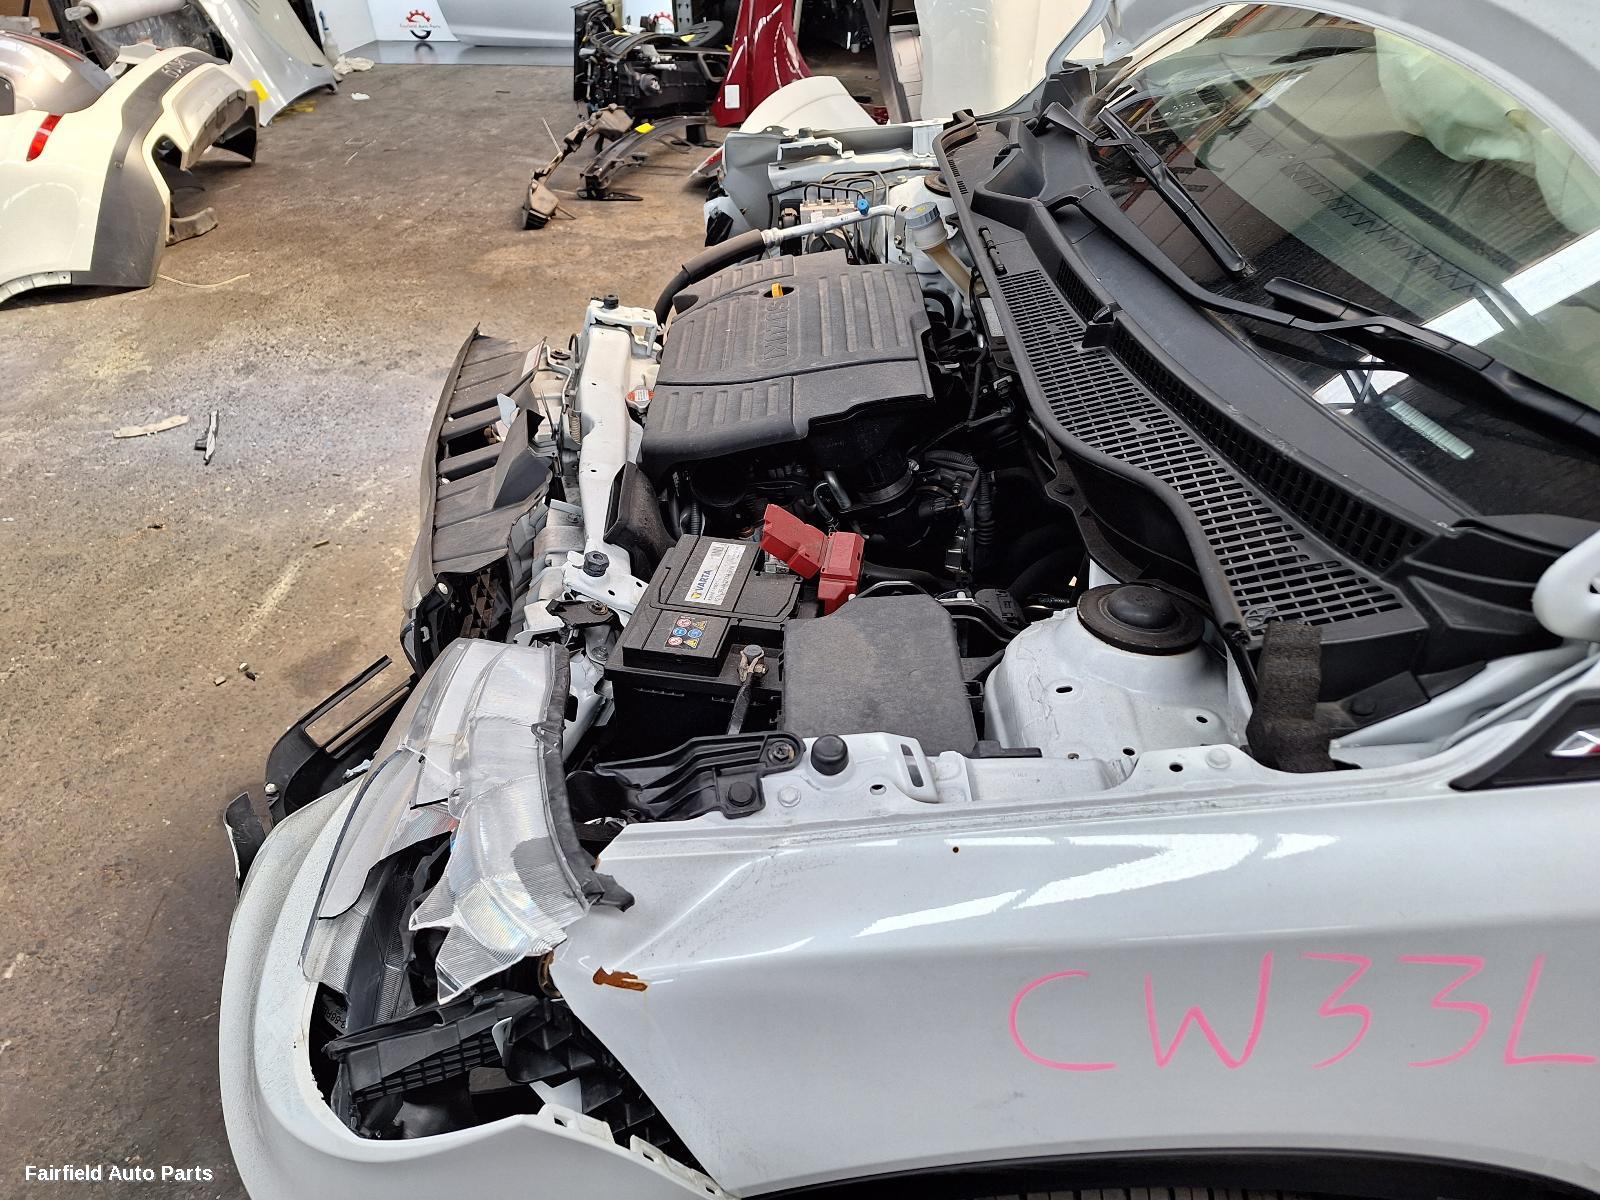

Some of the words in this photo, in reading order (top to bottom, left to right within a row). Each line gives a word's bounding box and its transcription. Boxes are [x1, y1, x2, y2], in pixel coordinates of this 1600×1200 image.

[764, 299, 790, 361] SUZUKI
[695, 569, 713, 592] VARTA
[1006, 950, 1600, 1072] CW33L
